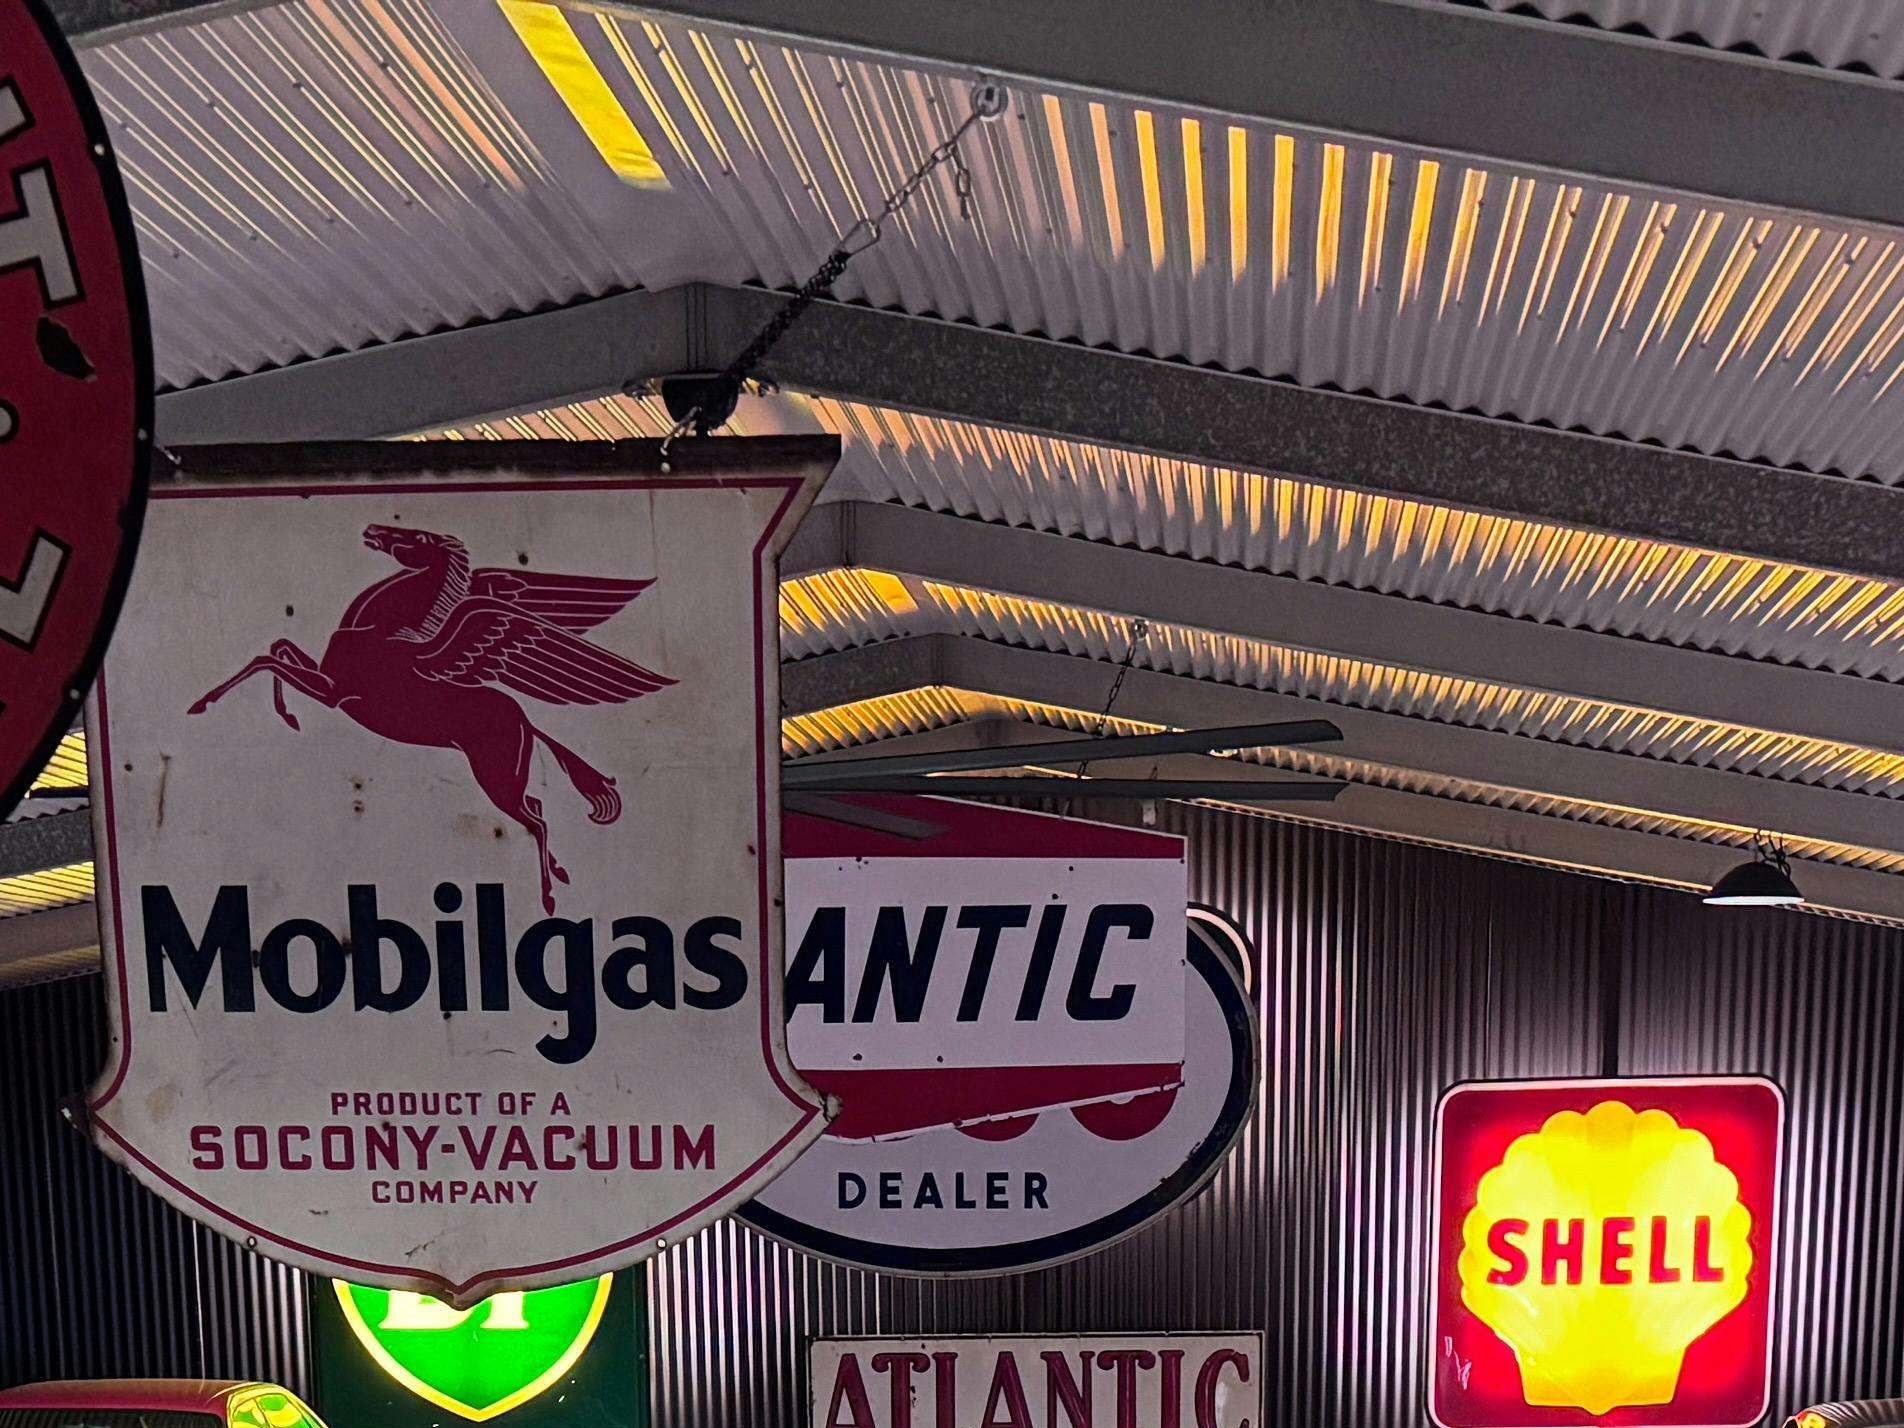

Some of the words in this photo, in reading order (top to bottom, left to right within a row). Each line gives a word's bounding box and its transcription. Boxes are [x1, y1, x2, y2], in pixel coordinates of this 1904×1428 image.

[140, 881, 749, 1065] Mobilgas
[330, 1091, 482, 1118] PRODUCT
[497, 1092, 536, 1116] OF
[549, 1092, 571, 1116] A
[190, 1122, 717, 1172] SOCONY-VACUUM
[371, 1179, 539, 1205] COMPANY
[837, 1170, 1050, 1210] DEALER
[1486, 1215, 1725, 1287] SHELL
